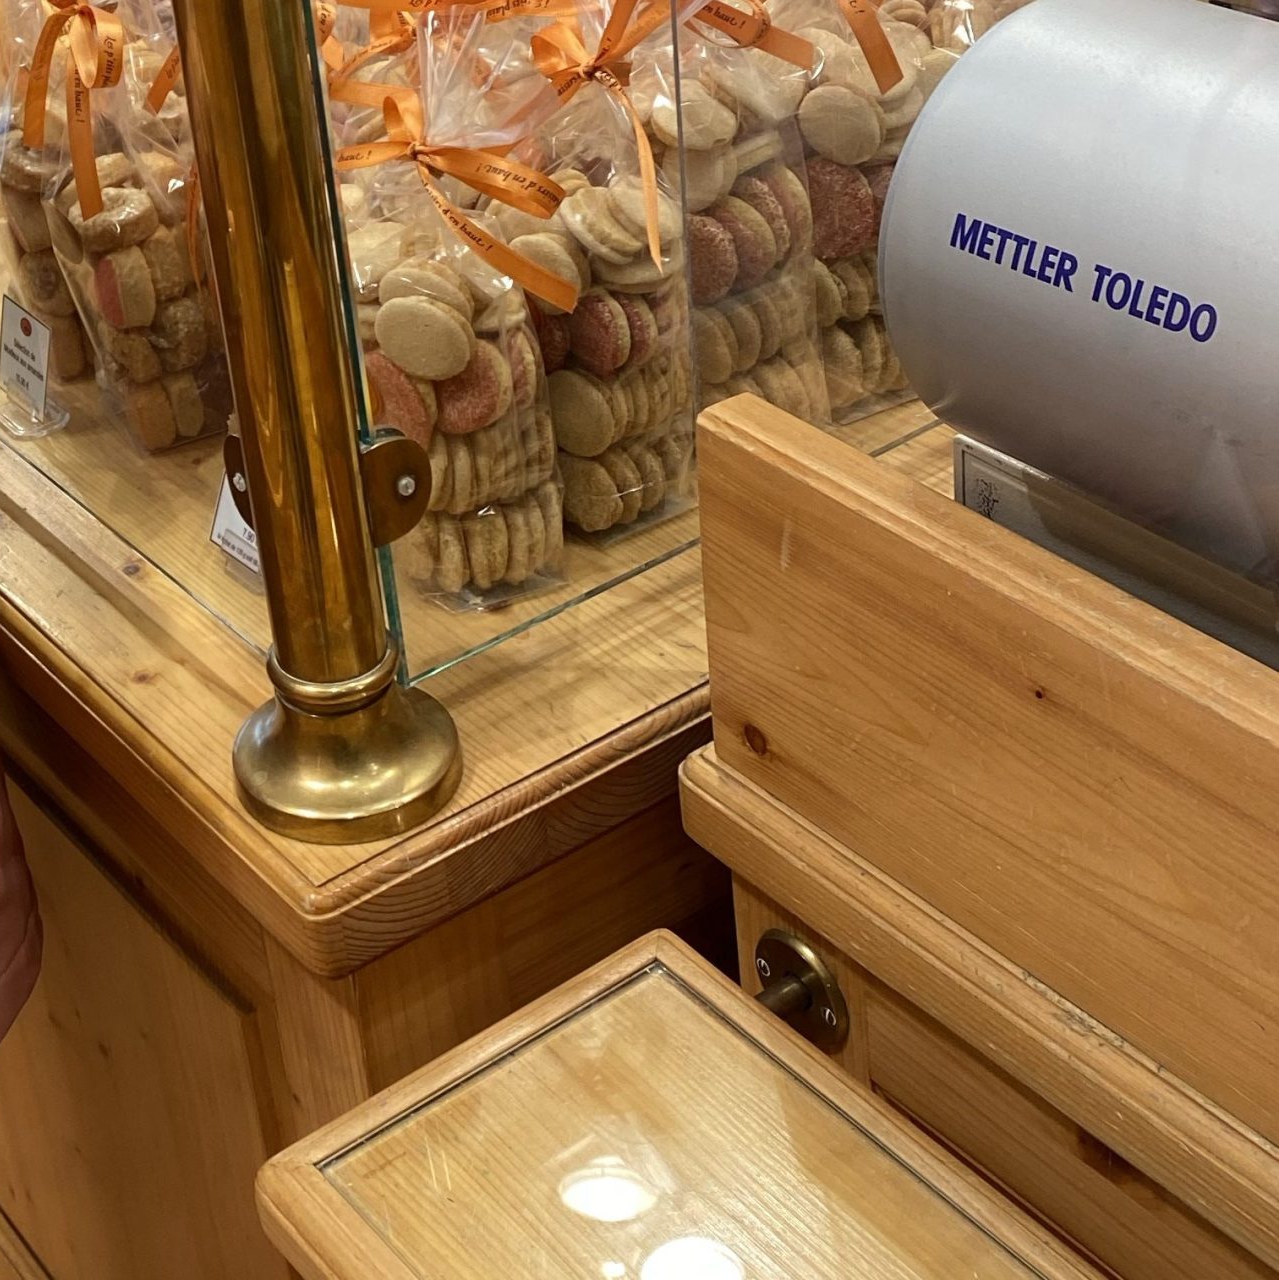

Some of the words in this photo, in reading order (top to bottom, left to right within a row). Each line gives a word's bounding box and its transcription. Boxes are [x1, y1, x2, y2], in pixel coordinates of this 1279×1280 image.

[711, 5, 740, 28] haut
[104, 35, 117, 56] Les
[364, 149, 373, 161] !
[483, 164, 513, 184] haut
[511, 173, 538, 193] d'en
[441, 207, 462, 229] d'en
[459, 220, 487, 248] haut
[949, 212, 1078, 293] METTLER
[1091, 263, 1218, 344] TOLEDO
